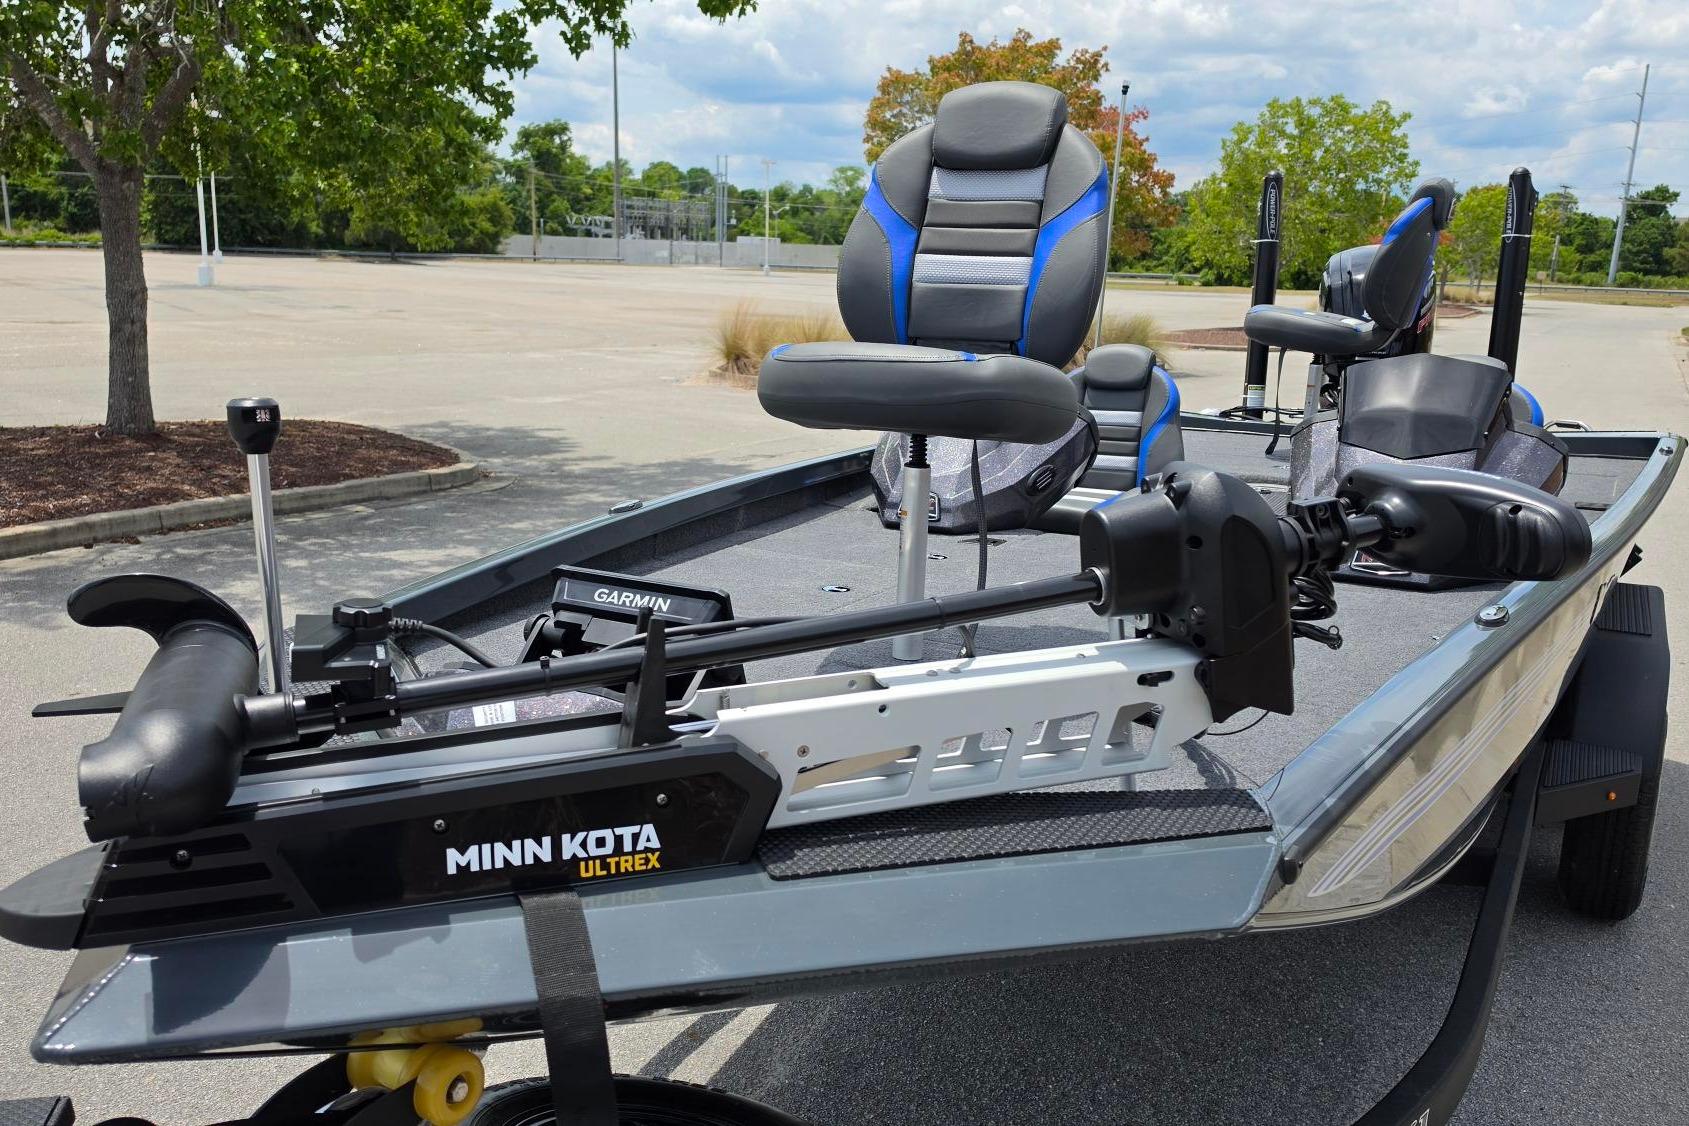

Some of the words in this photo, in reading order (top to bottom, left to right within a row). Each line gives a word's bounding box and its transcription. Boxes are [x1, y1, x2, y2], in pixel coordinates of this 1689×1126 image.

[593, 588, 671, 612] GARMIN
[446, 836, 551, 875] MINN
[561, 823, 662, 860] KOTA
[579, 851, 661, 878] ULTREX
